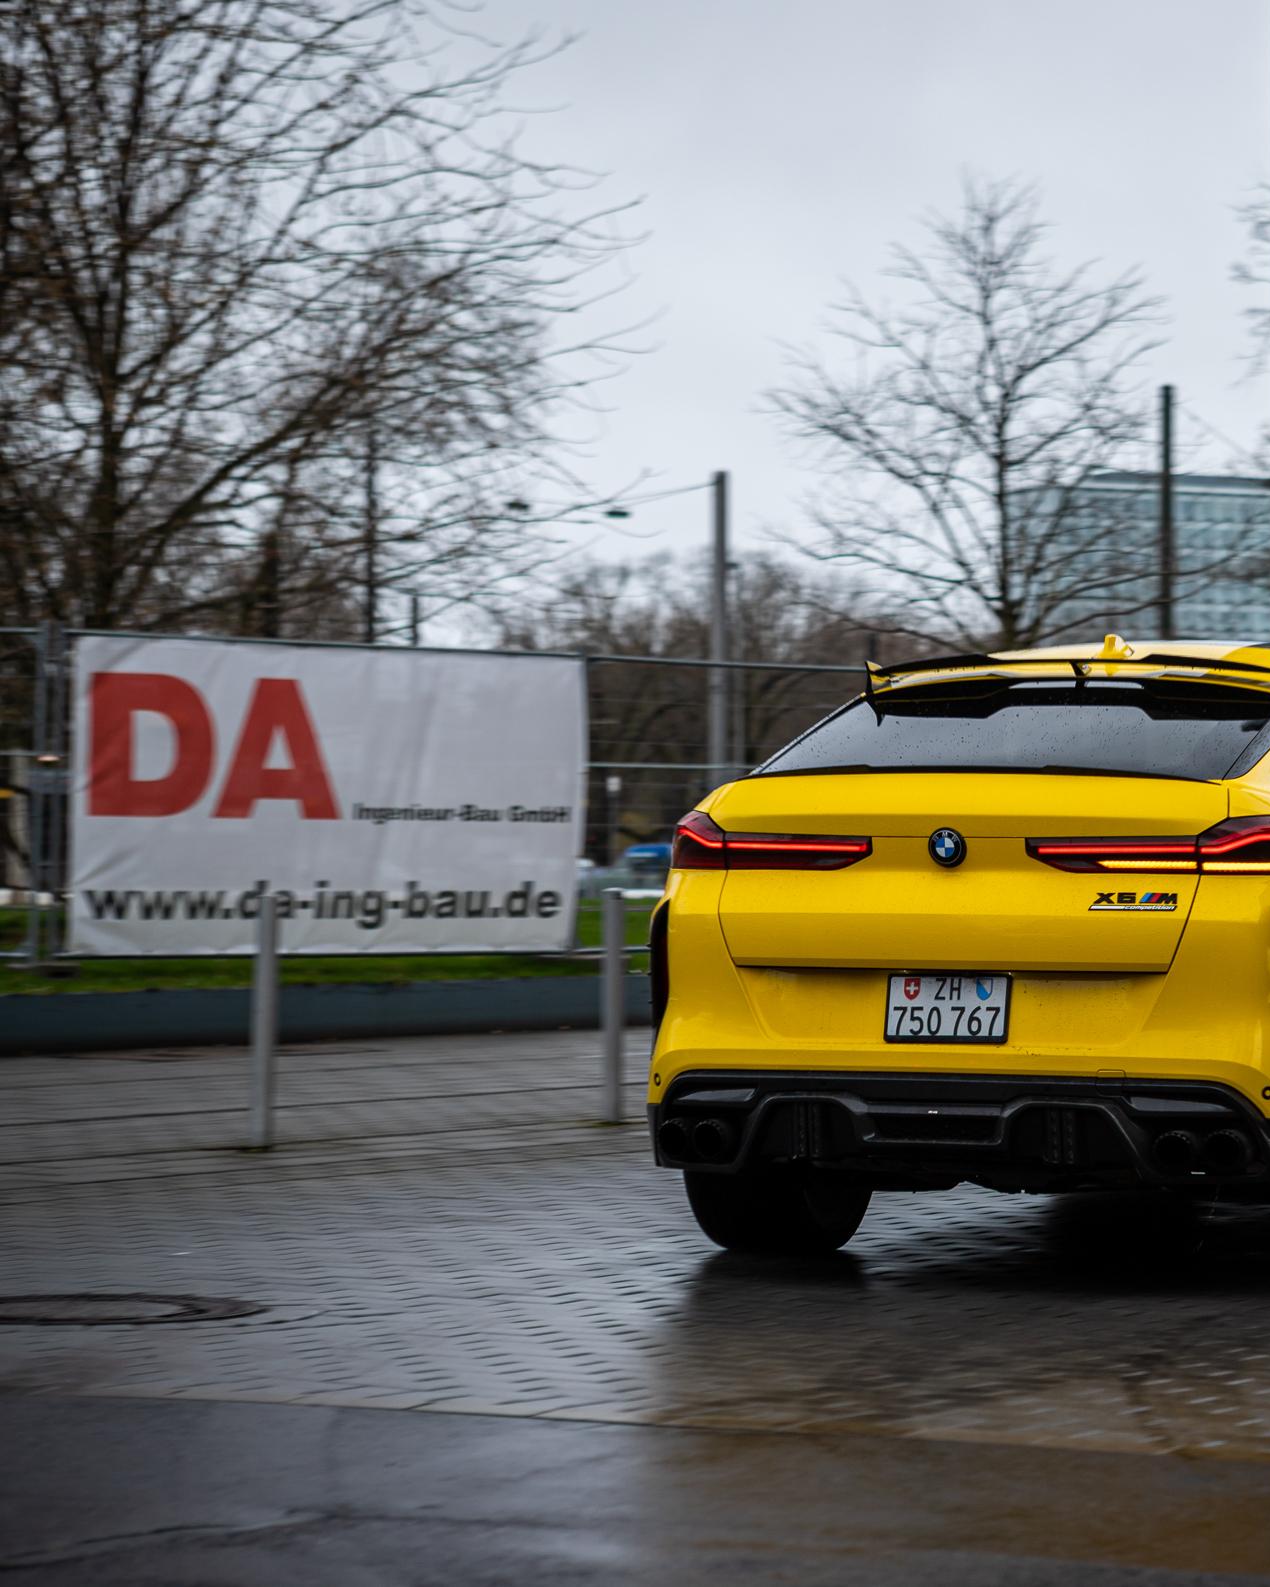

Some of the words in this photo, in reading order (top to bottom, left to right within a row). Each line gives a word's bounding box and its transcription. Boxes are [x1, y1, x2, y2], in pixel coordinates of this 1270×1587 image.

[85, 671, 343, 820] DA
[352, 803, 502, 824] Ingenieur-Bau
[507, 805, 573, 823] GmbH
[82, 880, 563, 929] www.da-ing-bau.de
[1093, 892, 1137, 904] X6
[934, 977, 963, 1001] ZH
[893, 1006, 942, 1036] 750
[951, 1006, 1001, 1036] 767
